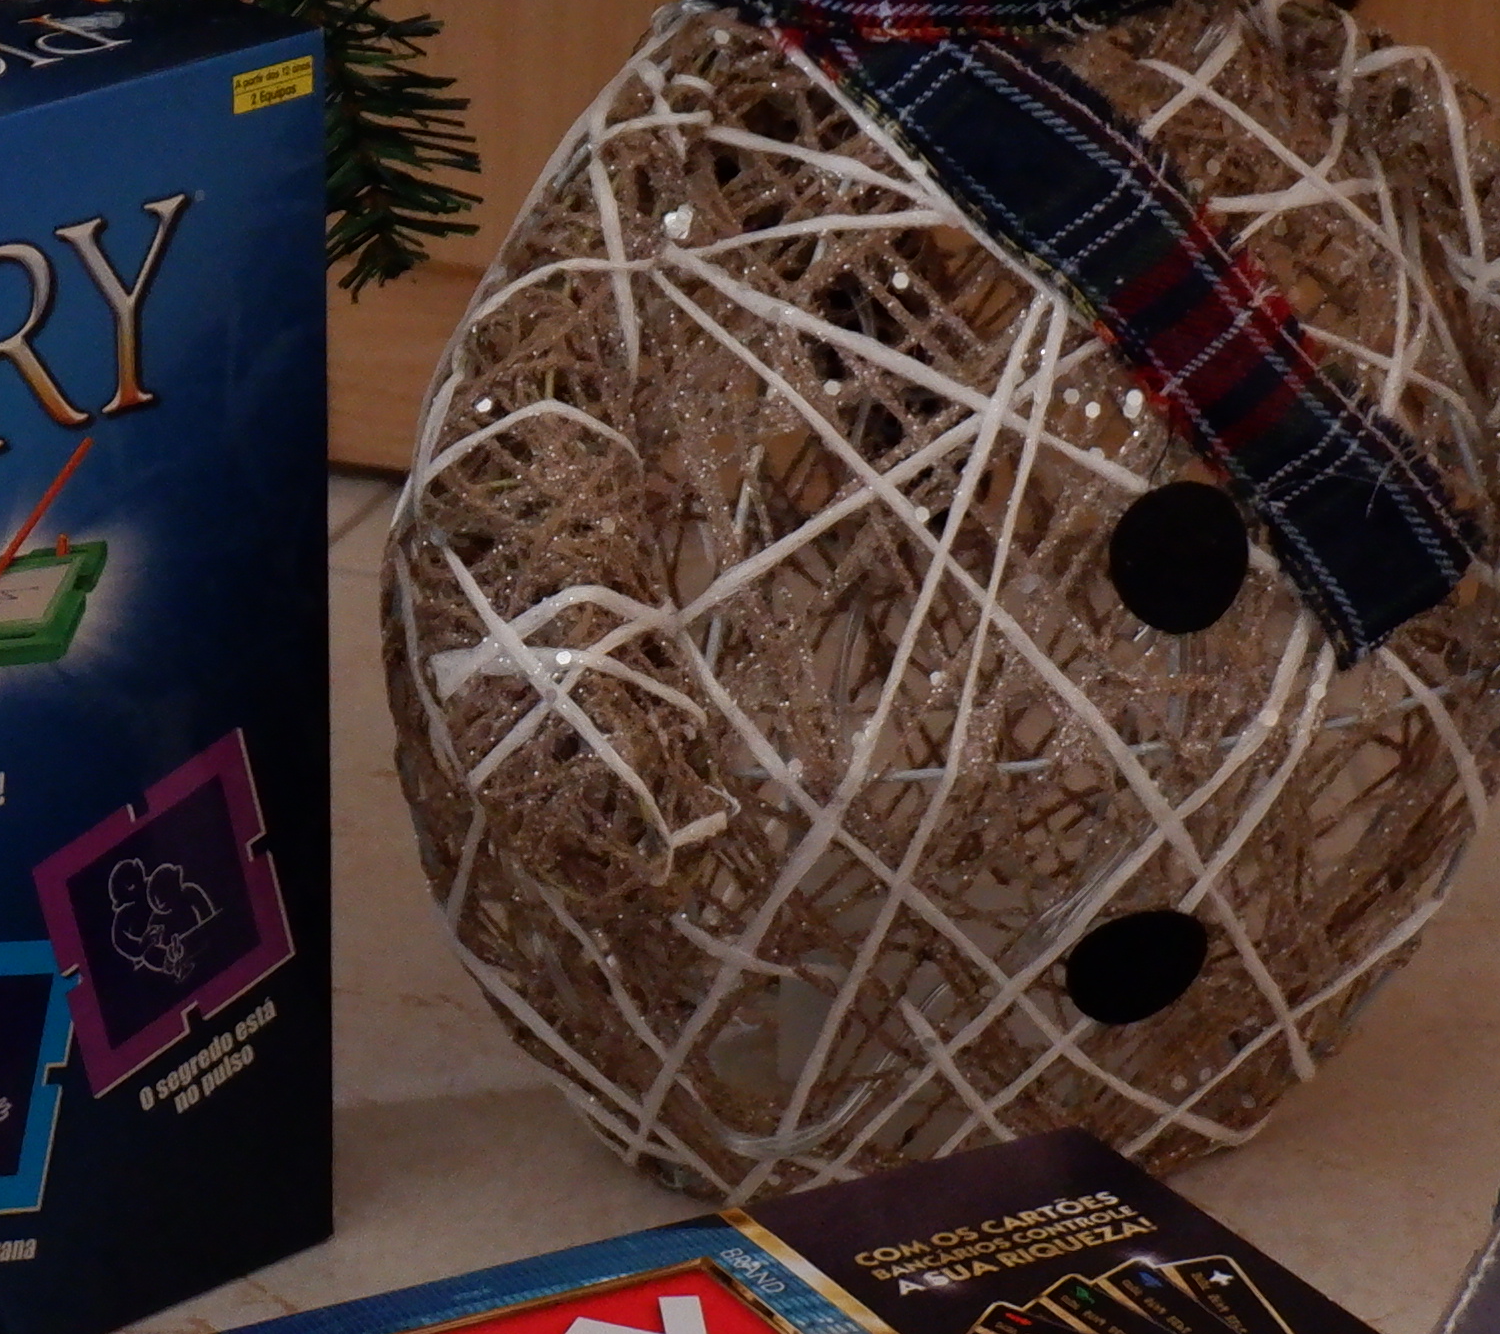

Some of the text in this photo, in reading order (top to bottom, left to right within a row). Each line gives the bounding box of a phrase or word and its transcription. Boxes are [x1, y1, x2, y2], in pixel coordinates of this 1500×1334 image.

[155, 1029, 236, 1101] segredo
[234, 996, 279, 1042] está
[172, 1043, 257, 1116] no pulso
[718, 1246, 787, 1295] BRAND
[853, 1189, 1120, 1271] COM OS CARTÕES
[870, 1202, 1136, 1283] BANCÁRIOS CONTROLE
[898, 1215, 1159, 1297] A SUA RIQUEZA!
